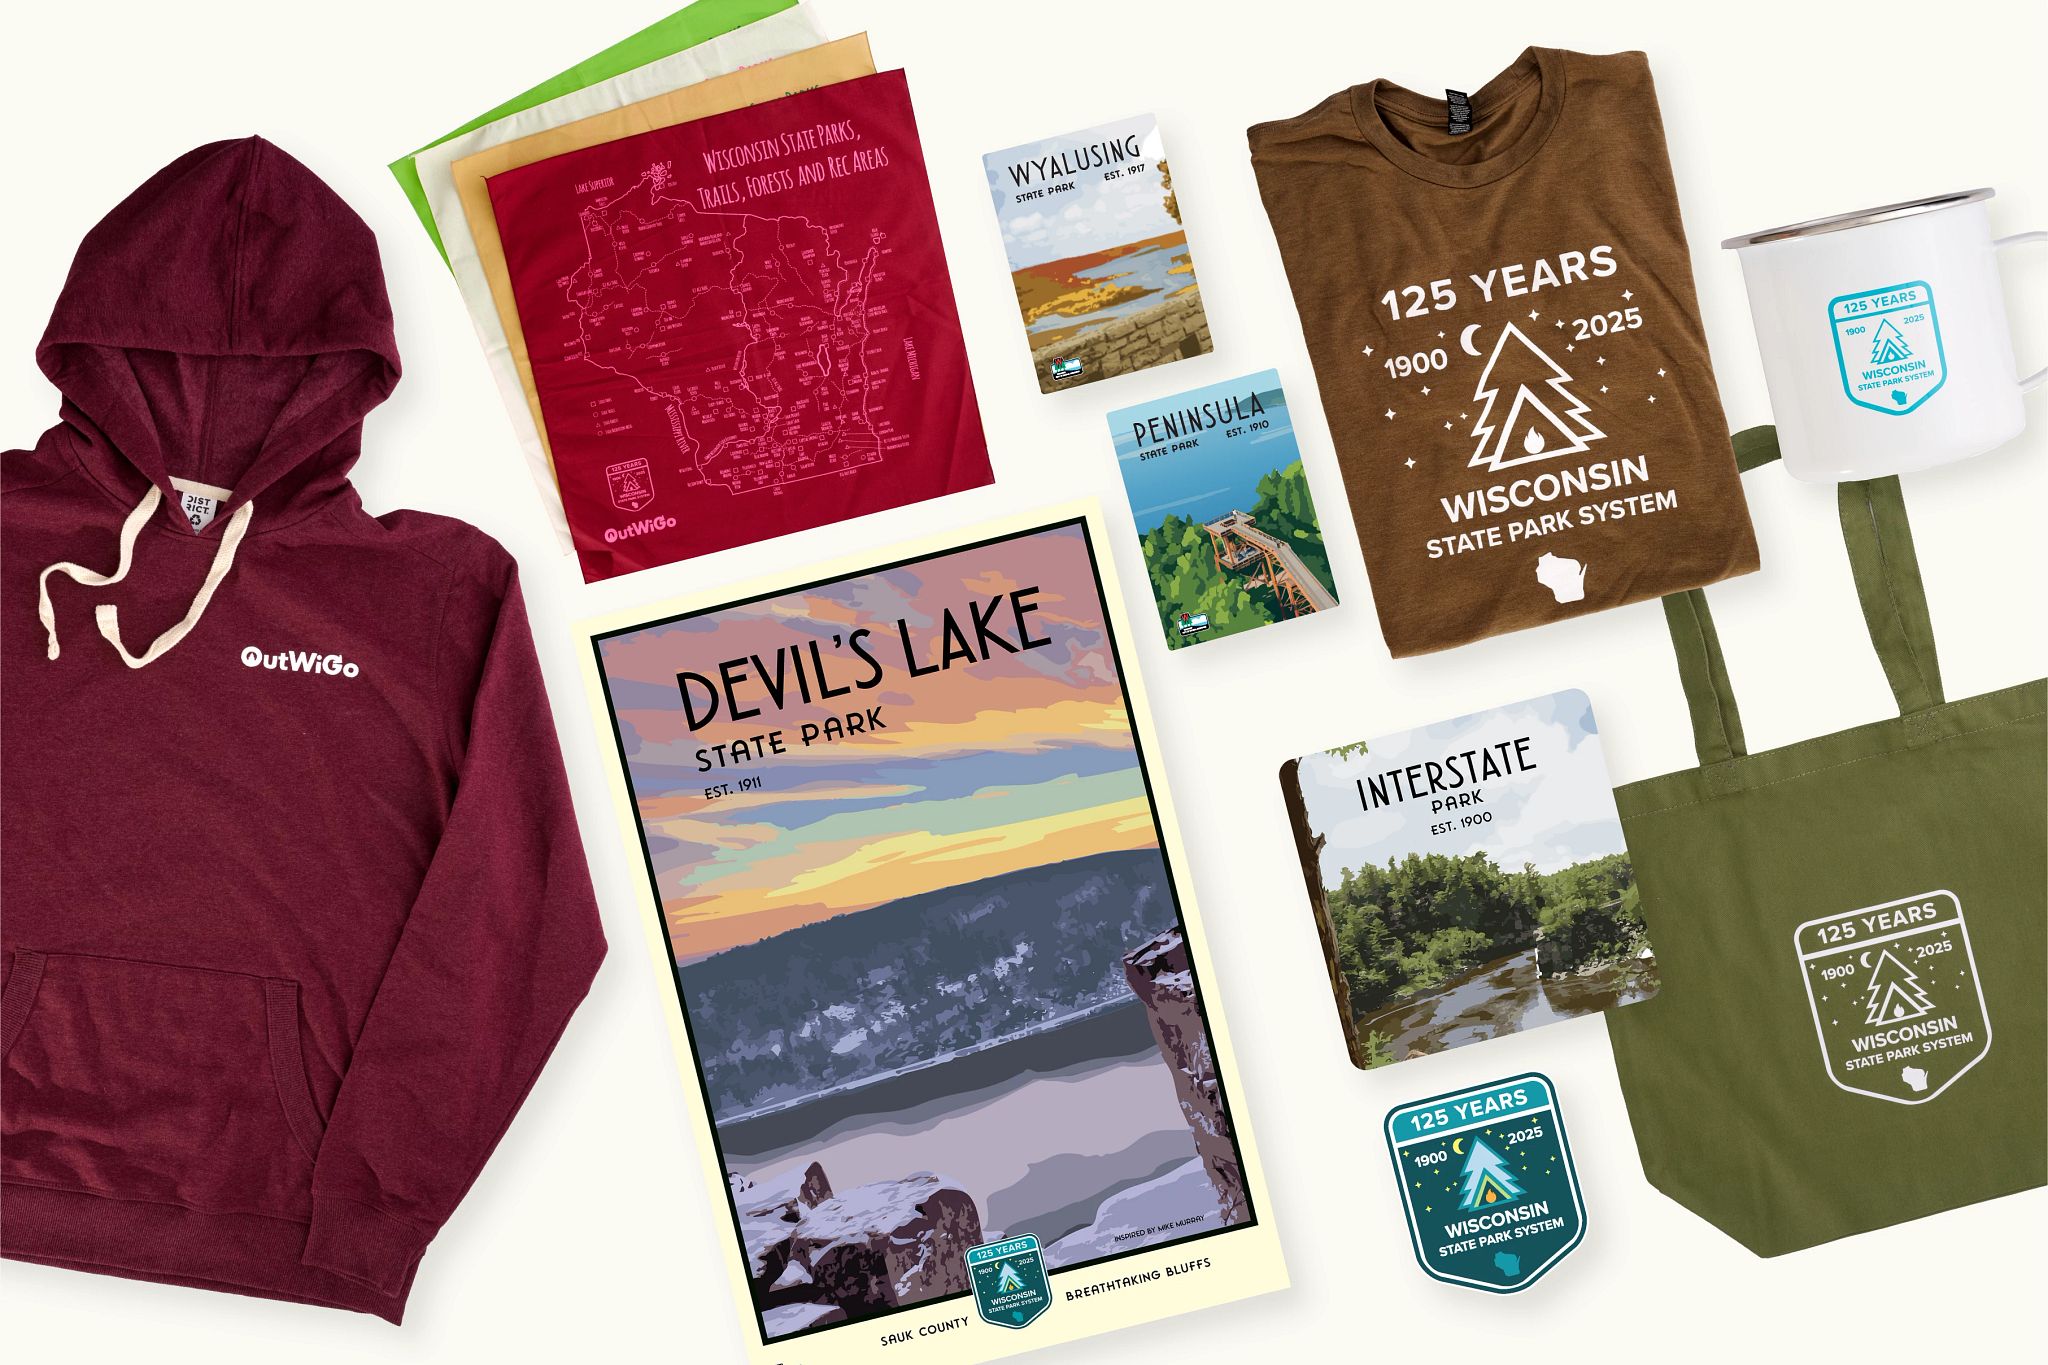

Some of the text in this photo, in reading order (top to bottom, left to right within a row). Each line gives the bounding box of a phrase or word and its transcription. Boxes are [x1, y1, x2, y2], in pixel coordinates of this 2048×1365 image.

[703, 120, 860, 174] WISCONSIN STATE PARKS,
[1008, 134, 1140, 187] WYALUSING
[1104, 164, 1145, 181] EST. 1917
[575, 177, 614, 194] LAKE SUPERIOR
[697, 147, 889, 209] TRAILS, FORESTS AND REC AREAS
[1016, 182, 1076, 204] STATE PARK
[1381, 245, 1618, 321] 125 YEARS
[1844, 290, 1916, 314] 125 YEARS
[1572, 307, 1643, 340] 2025
[1846, 326, 1866, 336] 1900
[1904, 314, 1924, 324] 2025
[1384, 348, 1448, 379] 1900
[1862, 360, 1926, 380] WISCONSIN
[1858, 370, 1934, 392] STATE PARK SYSTEM
[1133, 392, 1265, 447] PENINSULA
[1226, 420, 1270, 438] EST. 1910
[1140, 439, 1200, 461] STATE PARK
[623, 461, 642, 470] YEARS
[188, 496, 211, 506] DIST
[620, 490, 646, 498] WISCONSIN
[1440, 455, 1650, 523] WISCONSIN
[604, 515, 676, 542] OutWiGo
[1426, 489, 1678, 558] STATE PARK SYSTEM
[240, 646, 360, 678] OutWiGo
[676, 586, 1052, 732] DEVIL'S LAKE
[695, 706, 887, 772] STATE PARK
[1356, 736, 1536, 811] INTERSTATE
[704, 776, 762, 800] EST. 1911
[1432, 789, 1484, 814] PARK
[1431, 812, 1492, 835] EST. 1900
[1818, 903, 1936, 944] 125 YEARS
[1916, 940, 1952, 958] 2025
[1821, 964, 1854, 981] 1900
[1852, 1016, 1958, 1052] WISCONSIN
[1846, 1032, 1974, 1071] STATE PARK SYSTEM
[1410, 1089, 1528, 1132] 125 YEARS
[1508, 1126, 1543, 1144] 2025
[1414, 1150, 1448, 1168] 1900
[1114, 1215, 1204, 1242] INSPIRED BY MIKE MURRAY
[1444, 1200, 1549, 1239] WISCONSIN
[1439, 1216, 1564, 1257] STATE PARK SYSTEM
[977, 1240, 1028, 1260] 125 YEARS
[1019, 1257, 1034, 1266] 2025
[1066, 1258, 1212, 1301] BREATHTAKING BLUFFS
[988, 1296, 1043, 1314] STATE PARK SYSTEM
[991, 1290, 1036, 1306] WISCONSIN
[880, 1316, 969, 1346] SAUK COUNTY
